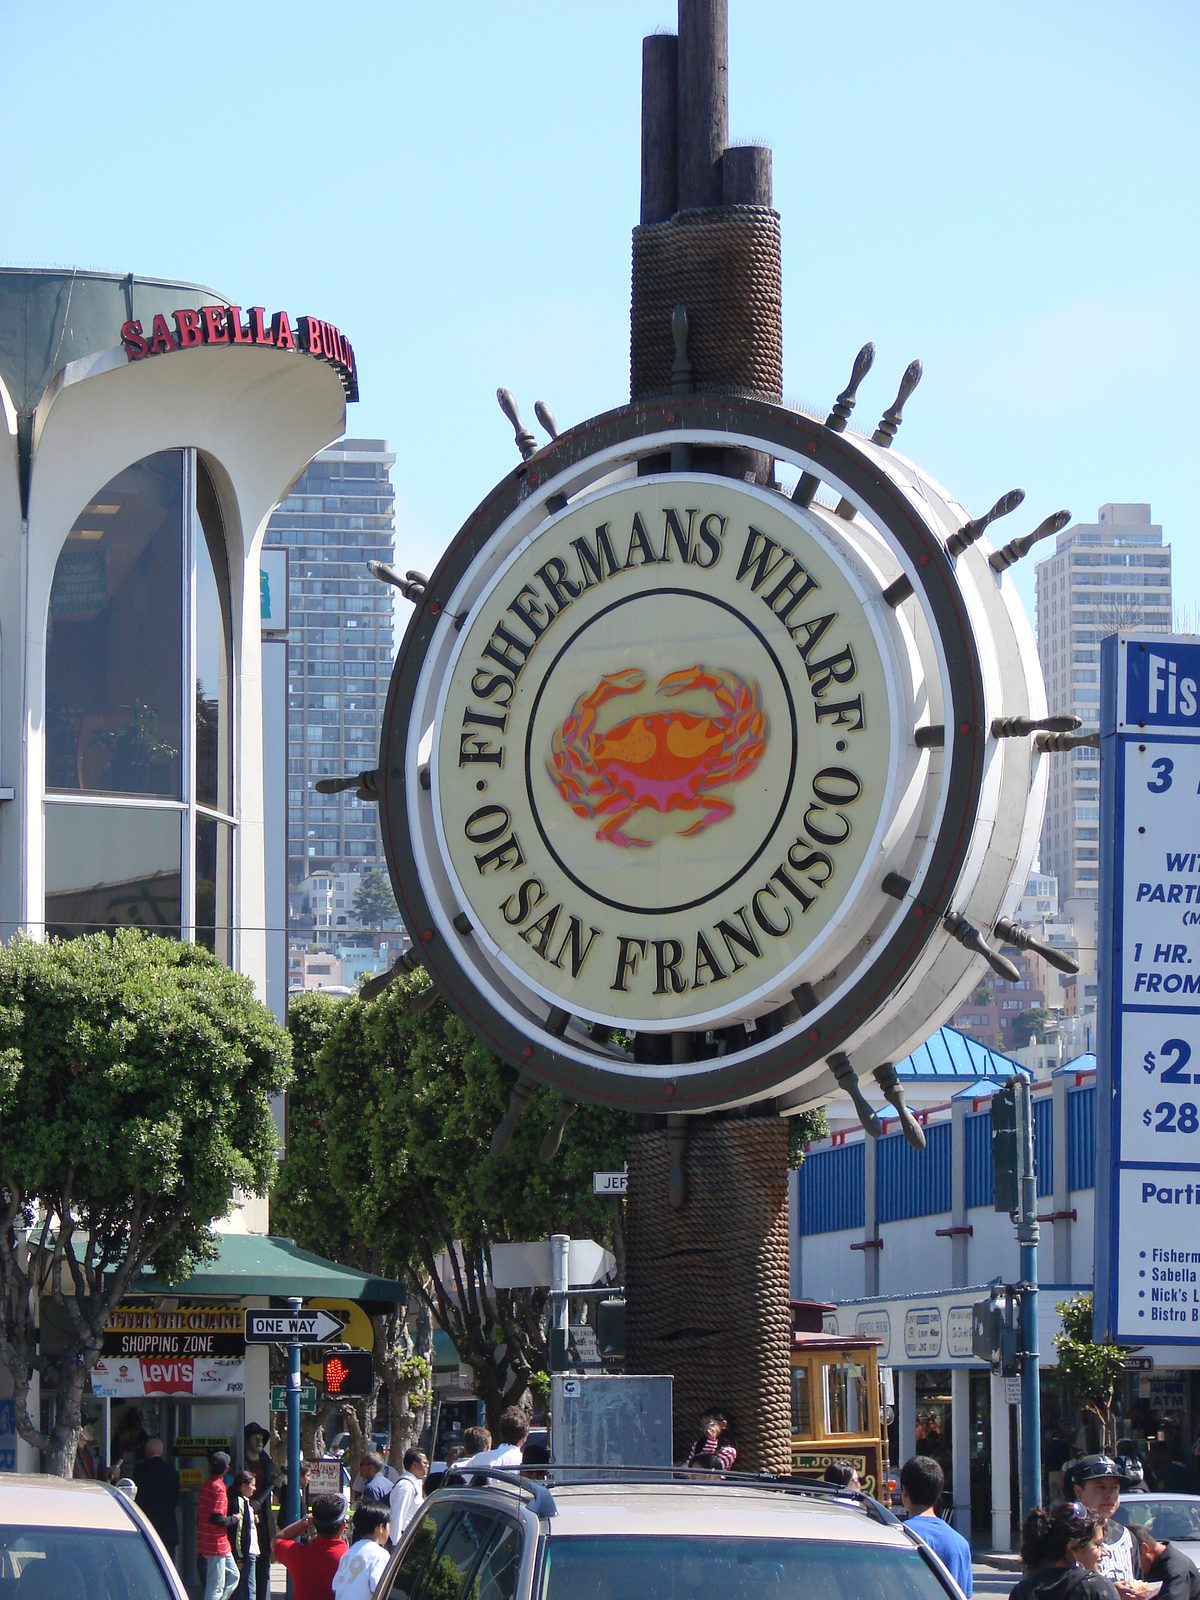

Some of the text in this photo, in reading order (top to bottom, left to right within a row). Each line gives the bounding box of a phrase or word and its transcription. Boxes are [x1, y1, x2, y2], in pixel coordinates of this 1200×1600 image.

[120, 305, 295, 361] SABELLA
[458, 507, 865, 768] FISHERMANS WHARF
[1148, 653, 1198, 717] Fis
[1146, 757, 1174, 794] 3
[464, 766, 862, 995] OF SAN FRANCISCO
[1134, 942, 1193, 964] 1 HR.
[1133, 972, 1200, 994] FROM
[1142, 1101, 1199, 1134] $28
[1151, 1266, 1197, 1282] Sabella
[1151, 1287, 1188, 1303] Nick's
[155, 1312, 186, 1330] THE
[188, 1312, 241, 1330] QUAKE
[1151, 1306, 1187, 1322] Bistro
[256, 1319, 316, 1333] ONE WAY
[122, 1335, 215, 1353] SHOPPING ZONE
[1153, 1396, 1184, 1407] ATM
